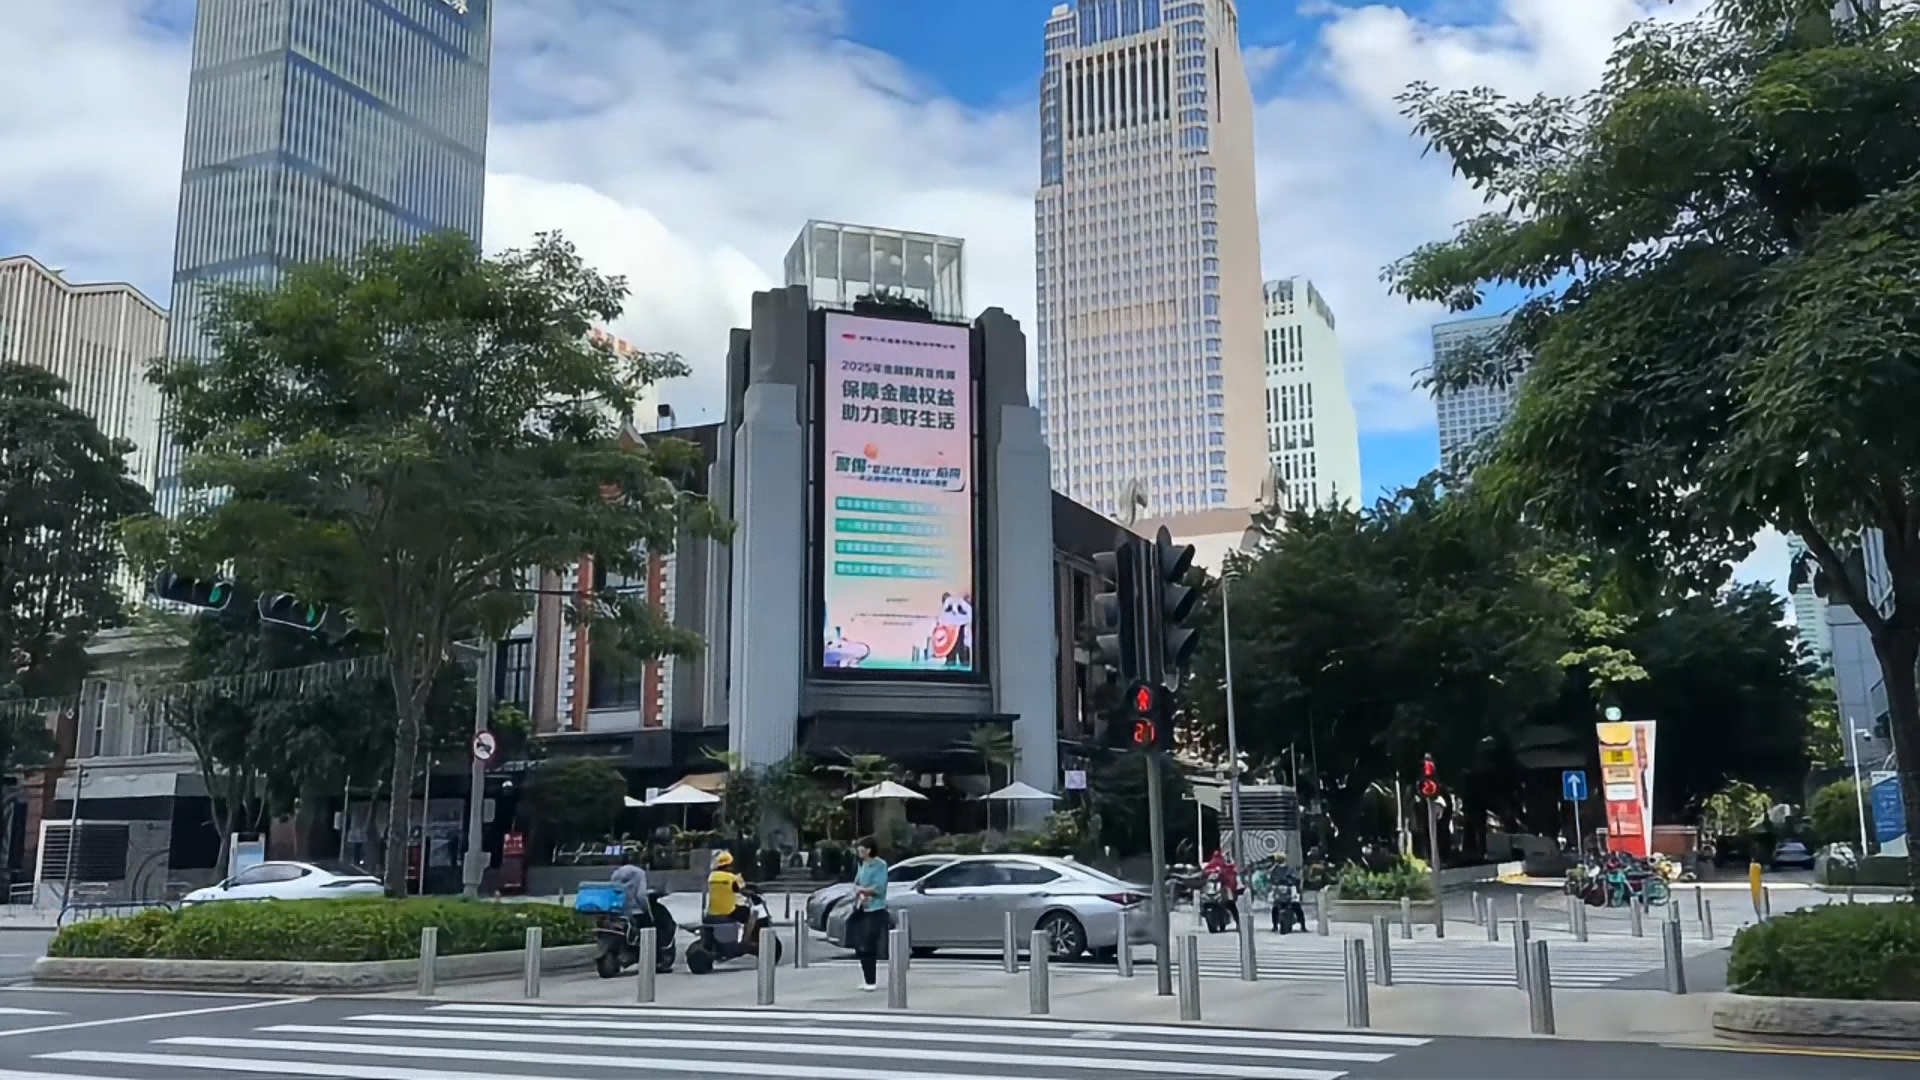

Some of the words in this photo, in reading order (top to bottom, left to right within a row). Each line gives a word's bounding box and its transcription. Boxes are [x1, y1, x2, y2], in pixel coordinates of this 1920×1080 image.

[842, 380, 955, 407] 保障金融权益
[842, 403, 955, 430] 助力美好生活
